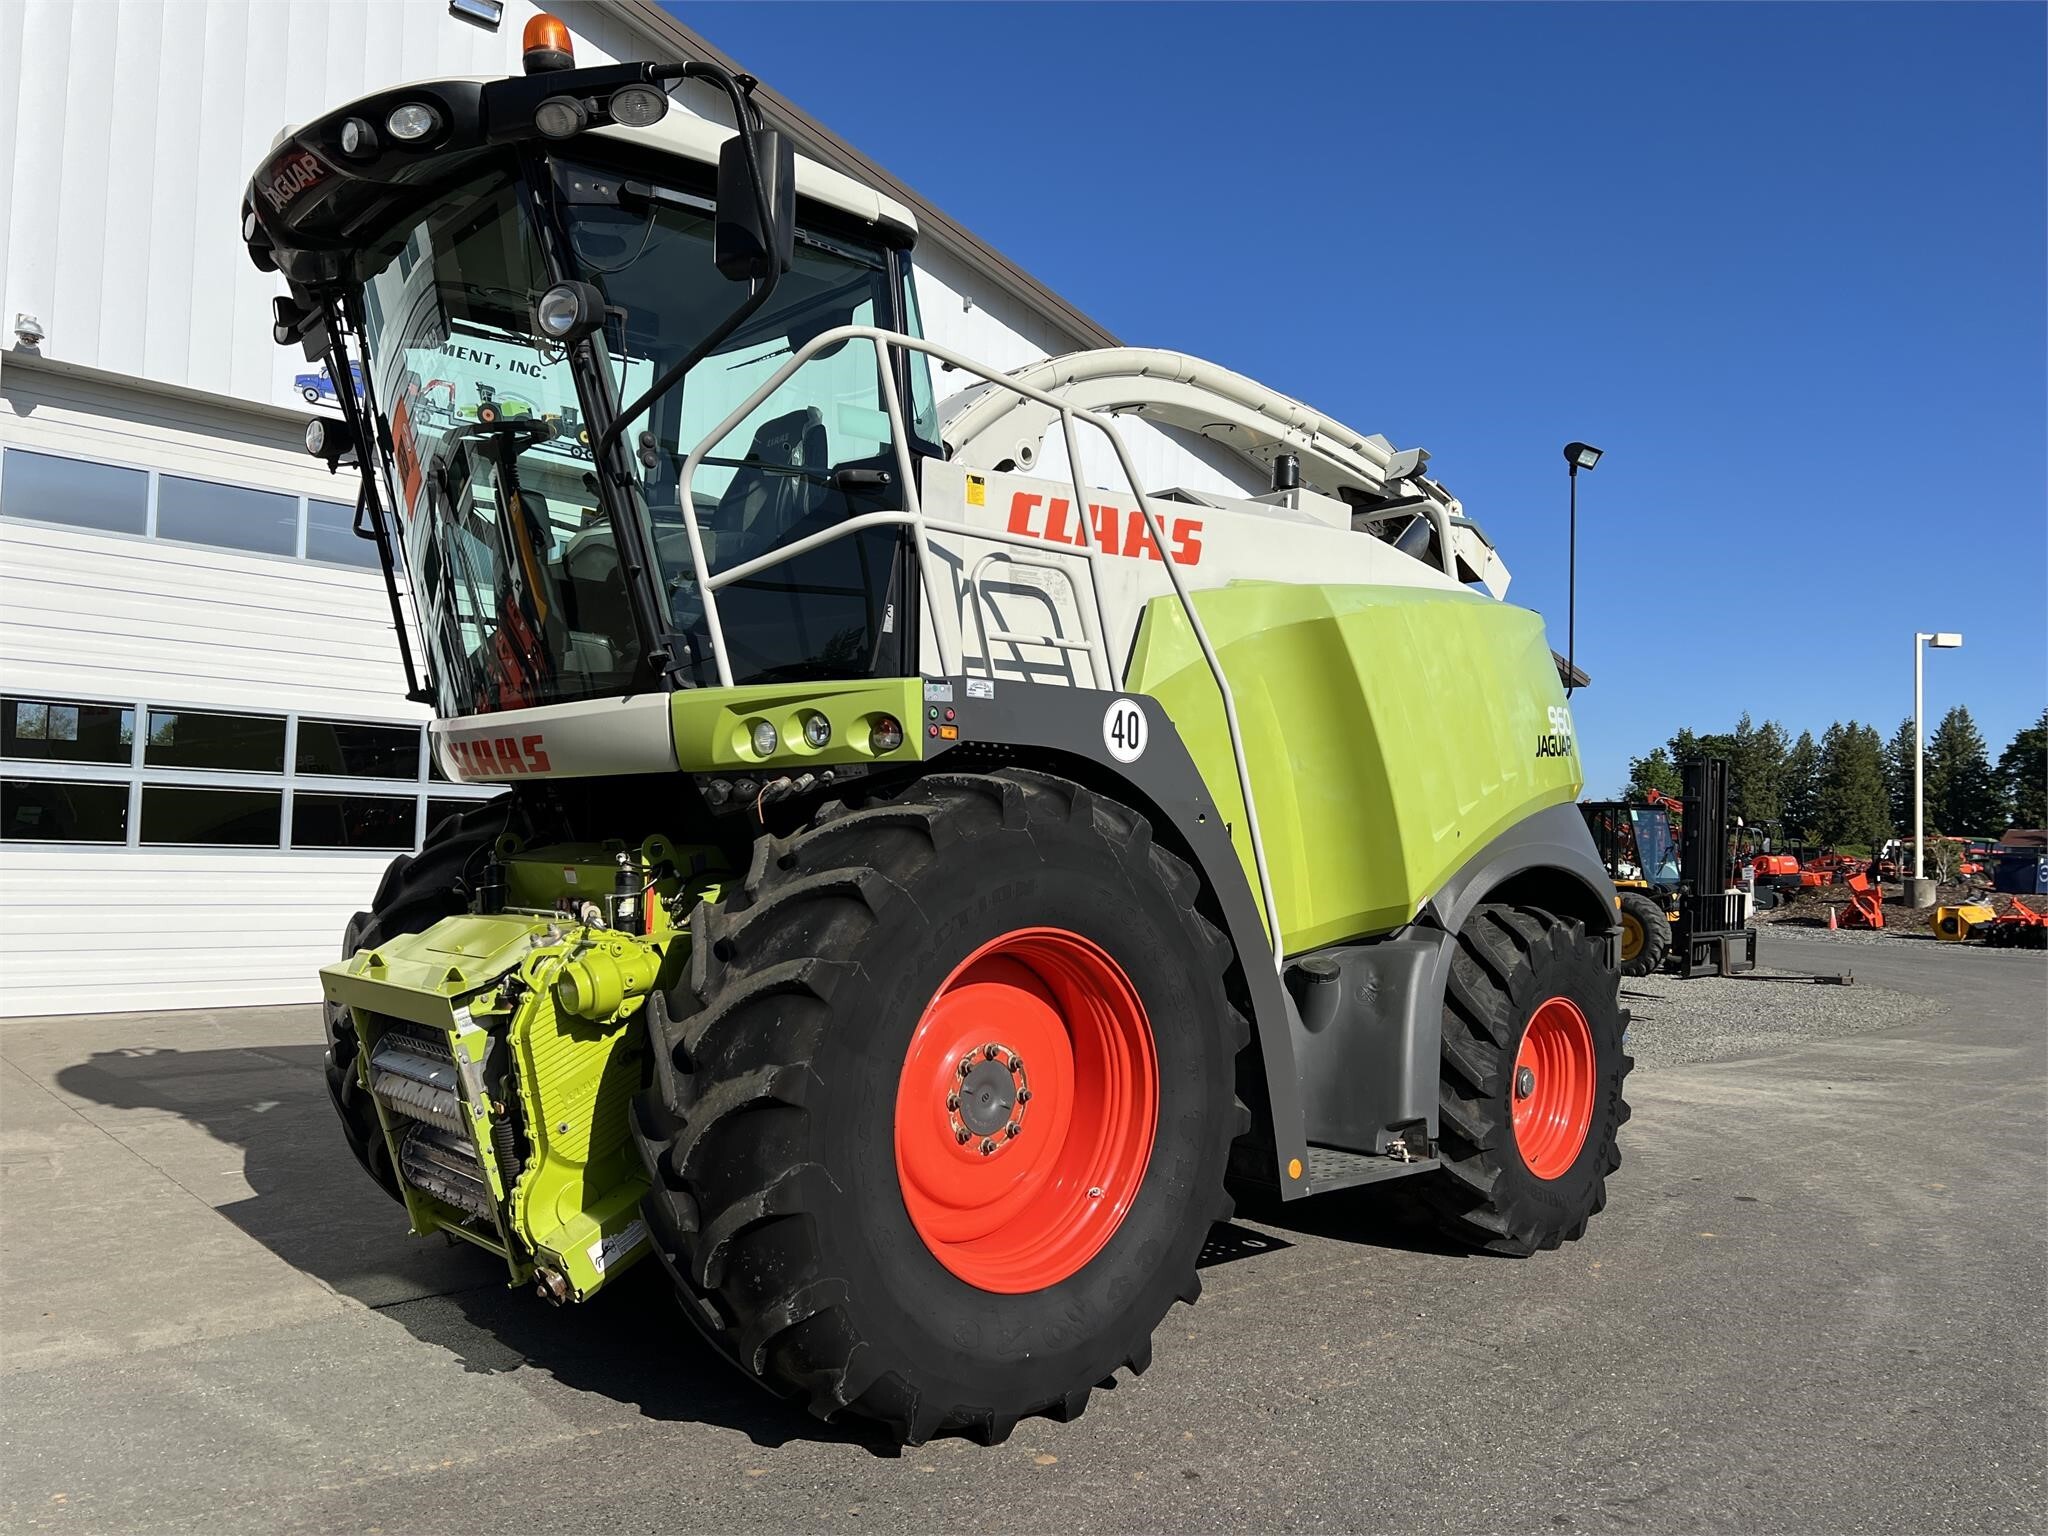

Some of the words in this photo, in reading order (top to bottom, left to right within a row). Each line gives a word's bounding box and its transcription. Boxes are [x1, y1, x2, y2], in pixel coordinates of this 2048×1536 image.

[262, 153, 324, 214] JAGUAR
[509, 359, 548, 381] INC.
[1006, 491, 1204, 566] CLAAS
[1111, 709, 1140, 750] 40
[1547, 705, 1572, 736] 960
[448, 734, 552, 777] CLAAS
[1535, 734, 1574, 758] JAGUAR
